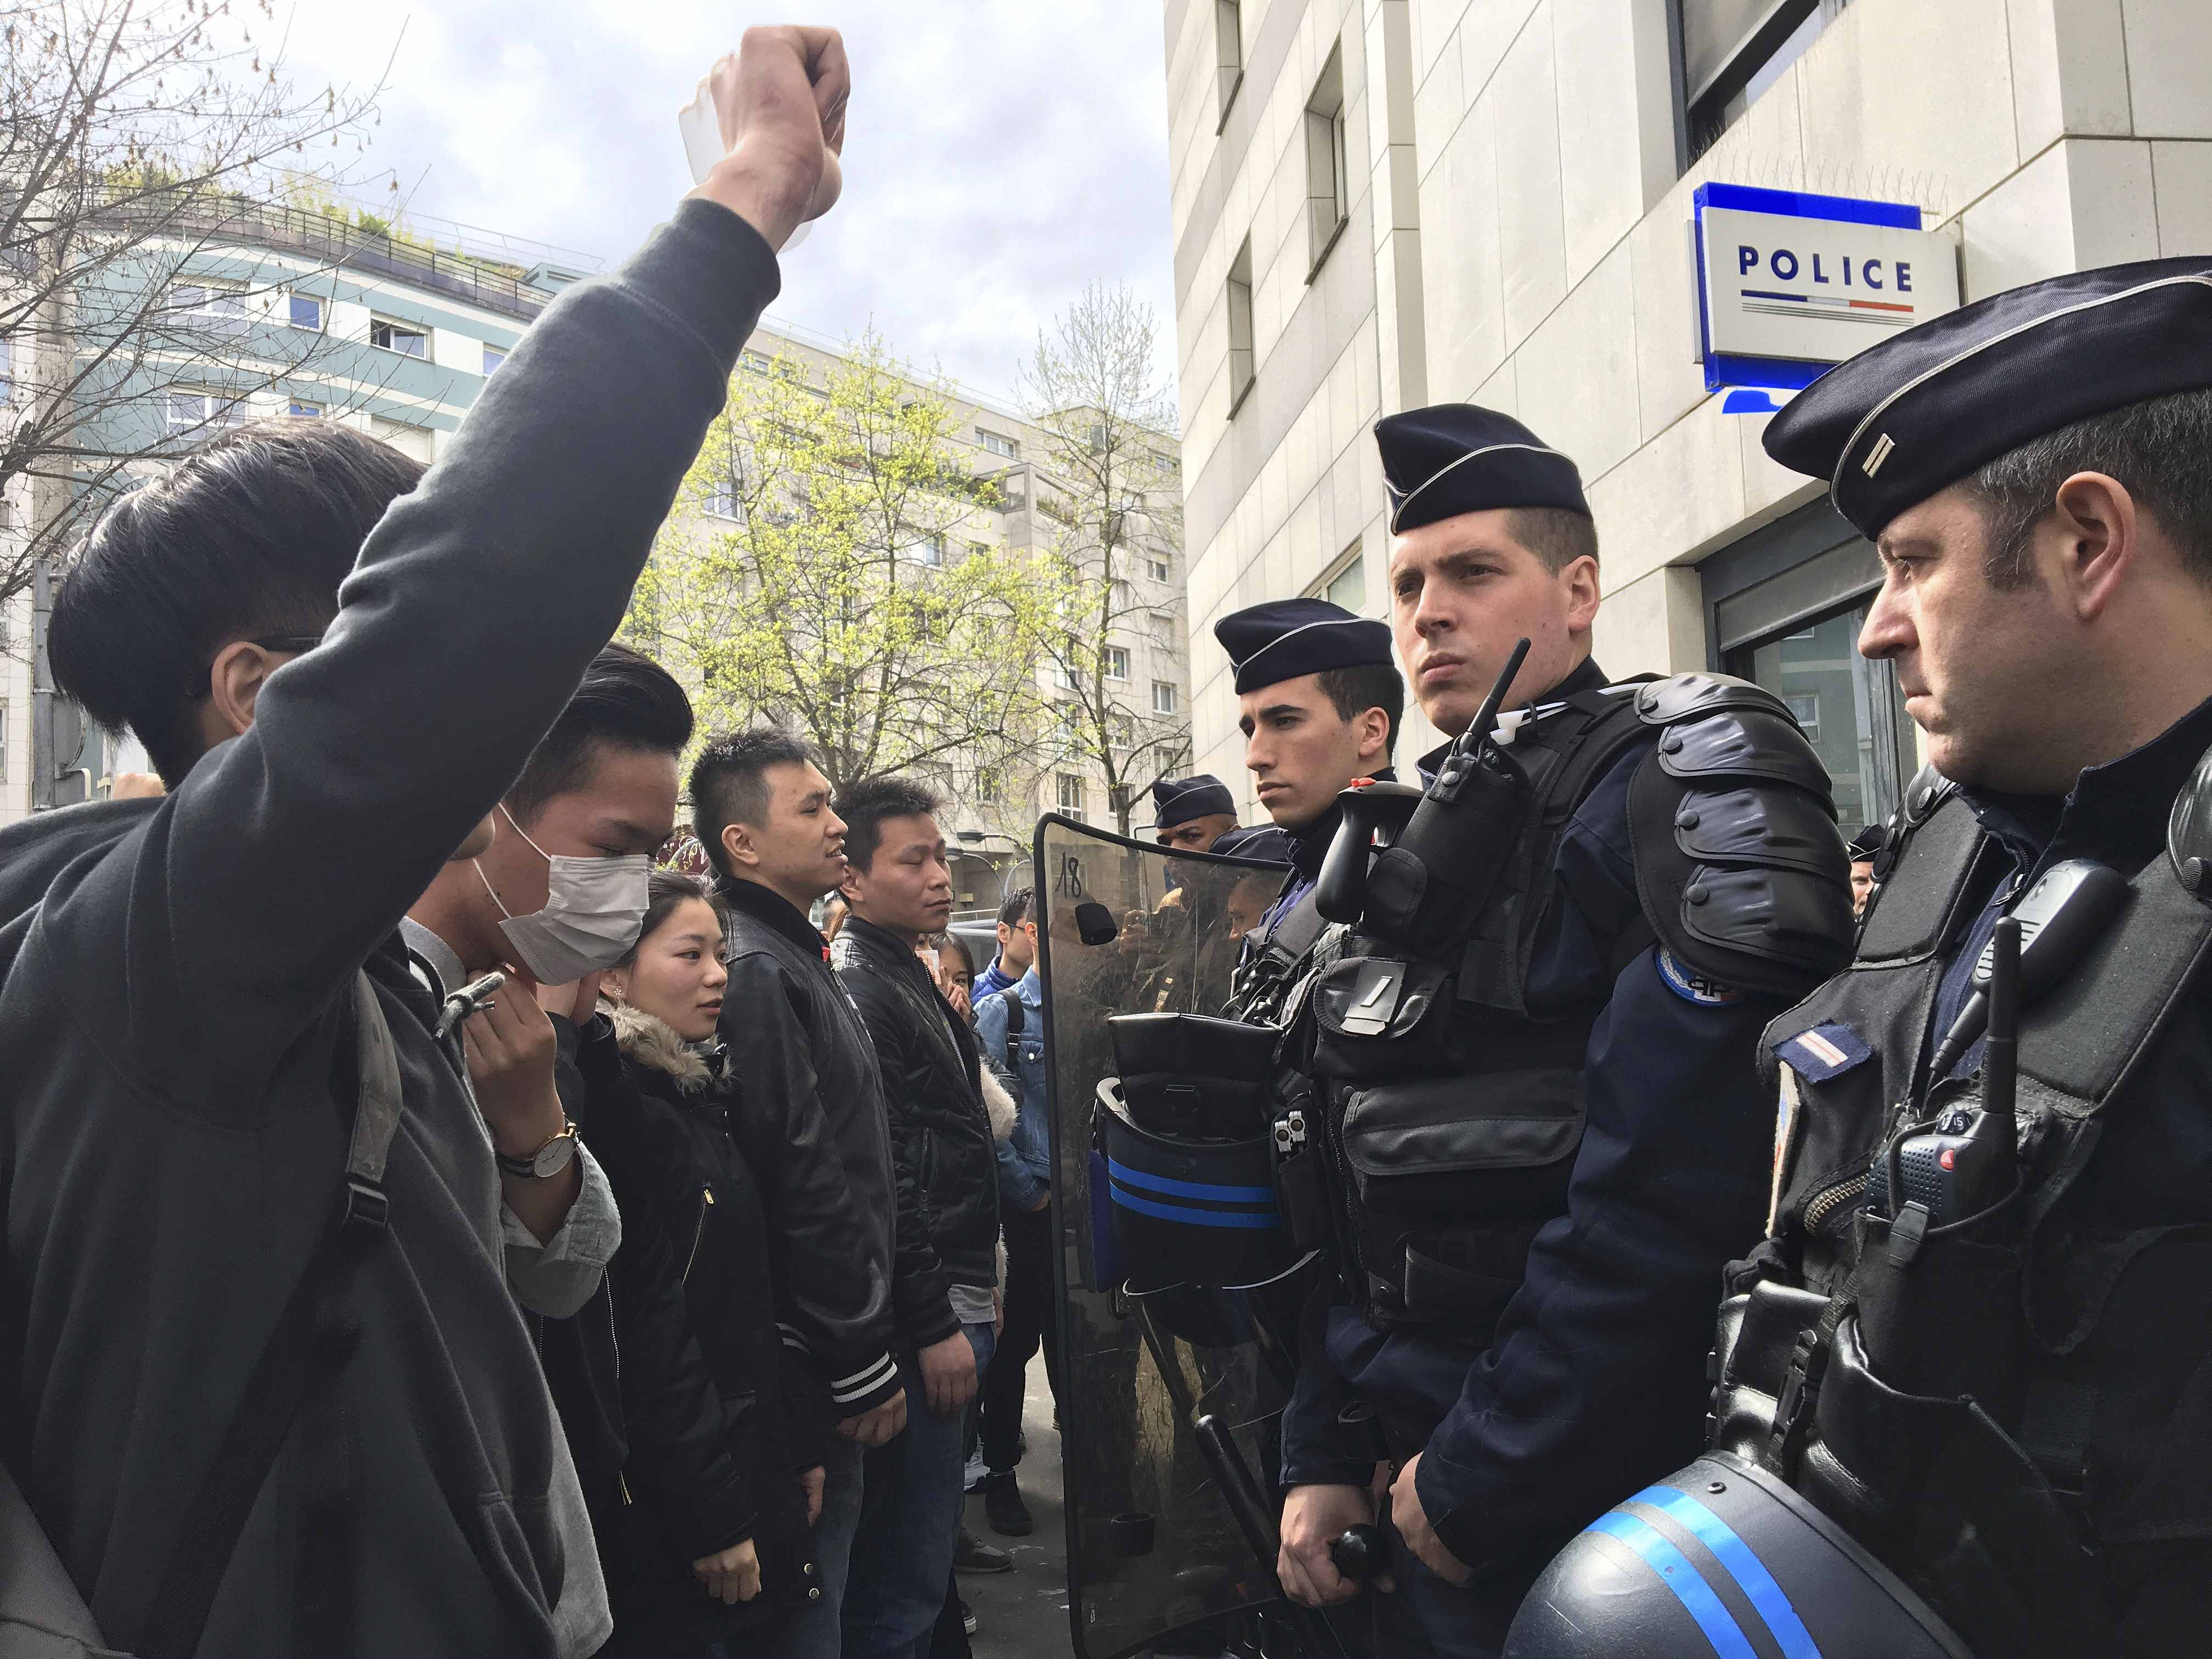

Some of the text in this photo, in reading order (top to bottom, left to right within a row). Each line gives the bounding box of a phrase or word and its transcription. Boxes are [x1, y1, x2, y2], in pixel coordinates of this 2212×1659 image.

[1739, 245, 1912, 292] POLICE
[1055, 851, 1082, 899] 18
[1954, 1116, 1964, 1126] 15
